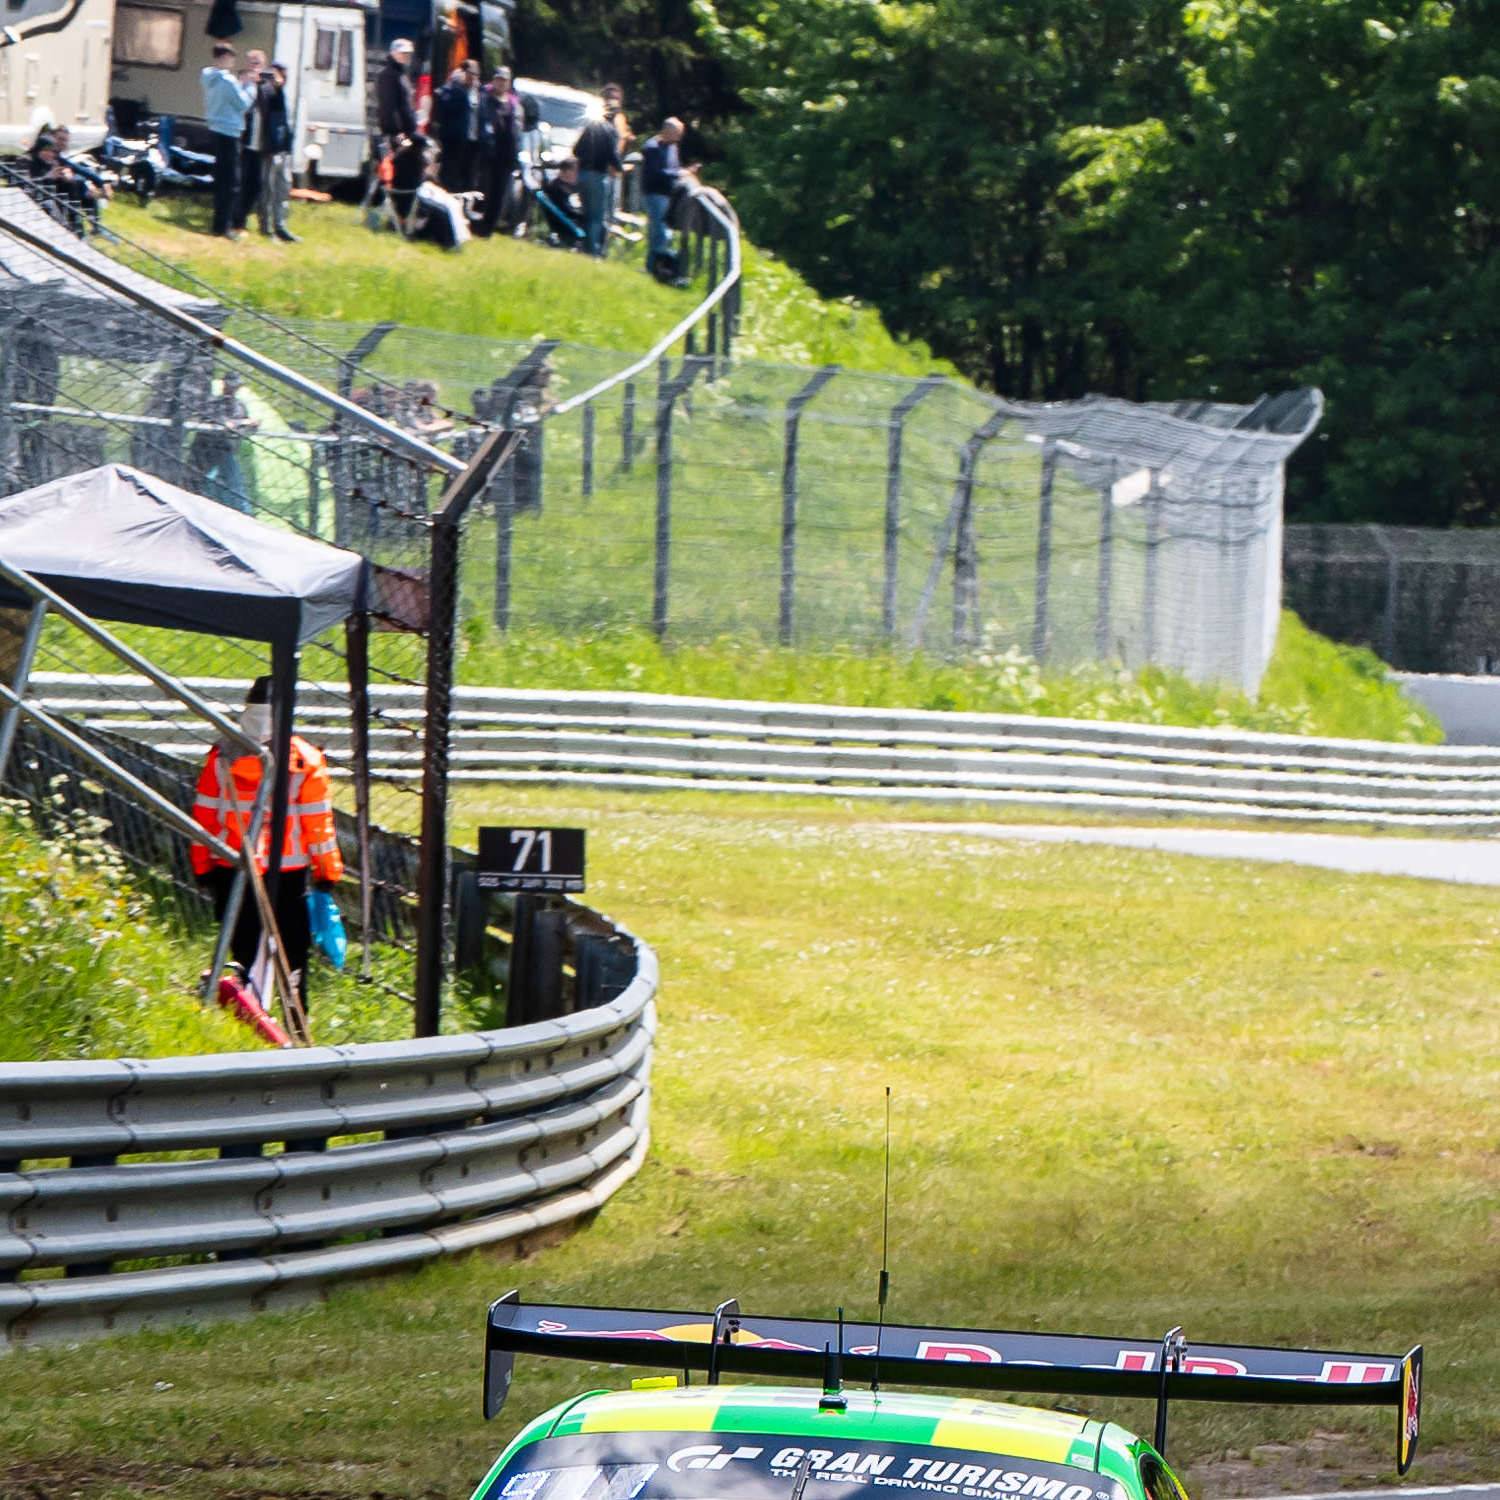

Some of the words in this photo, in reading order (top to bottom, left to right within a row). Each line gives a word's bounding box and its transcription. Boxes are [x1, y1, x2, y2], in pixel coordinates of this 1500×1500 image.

[509, 829, 551, 872] 71
[770, 1447, 896, 1476] GRAN
[770, 1468, 812, 1480] TH
[815, 1472, 869, 1485] REAL
[874, 1477, 959, 1494] DRIVING
